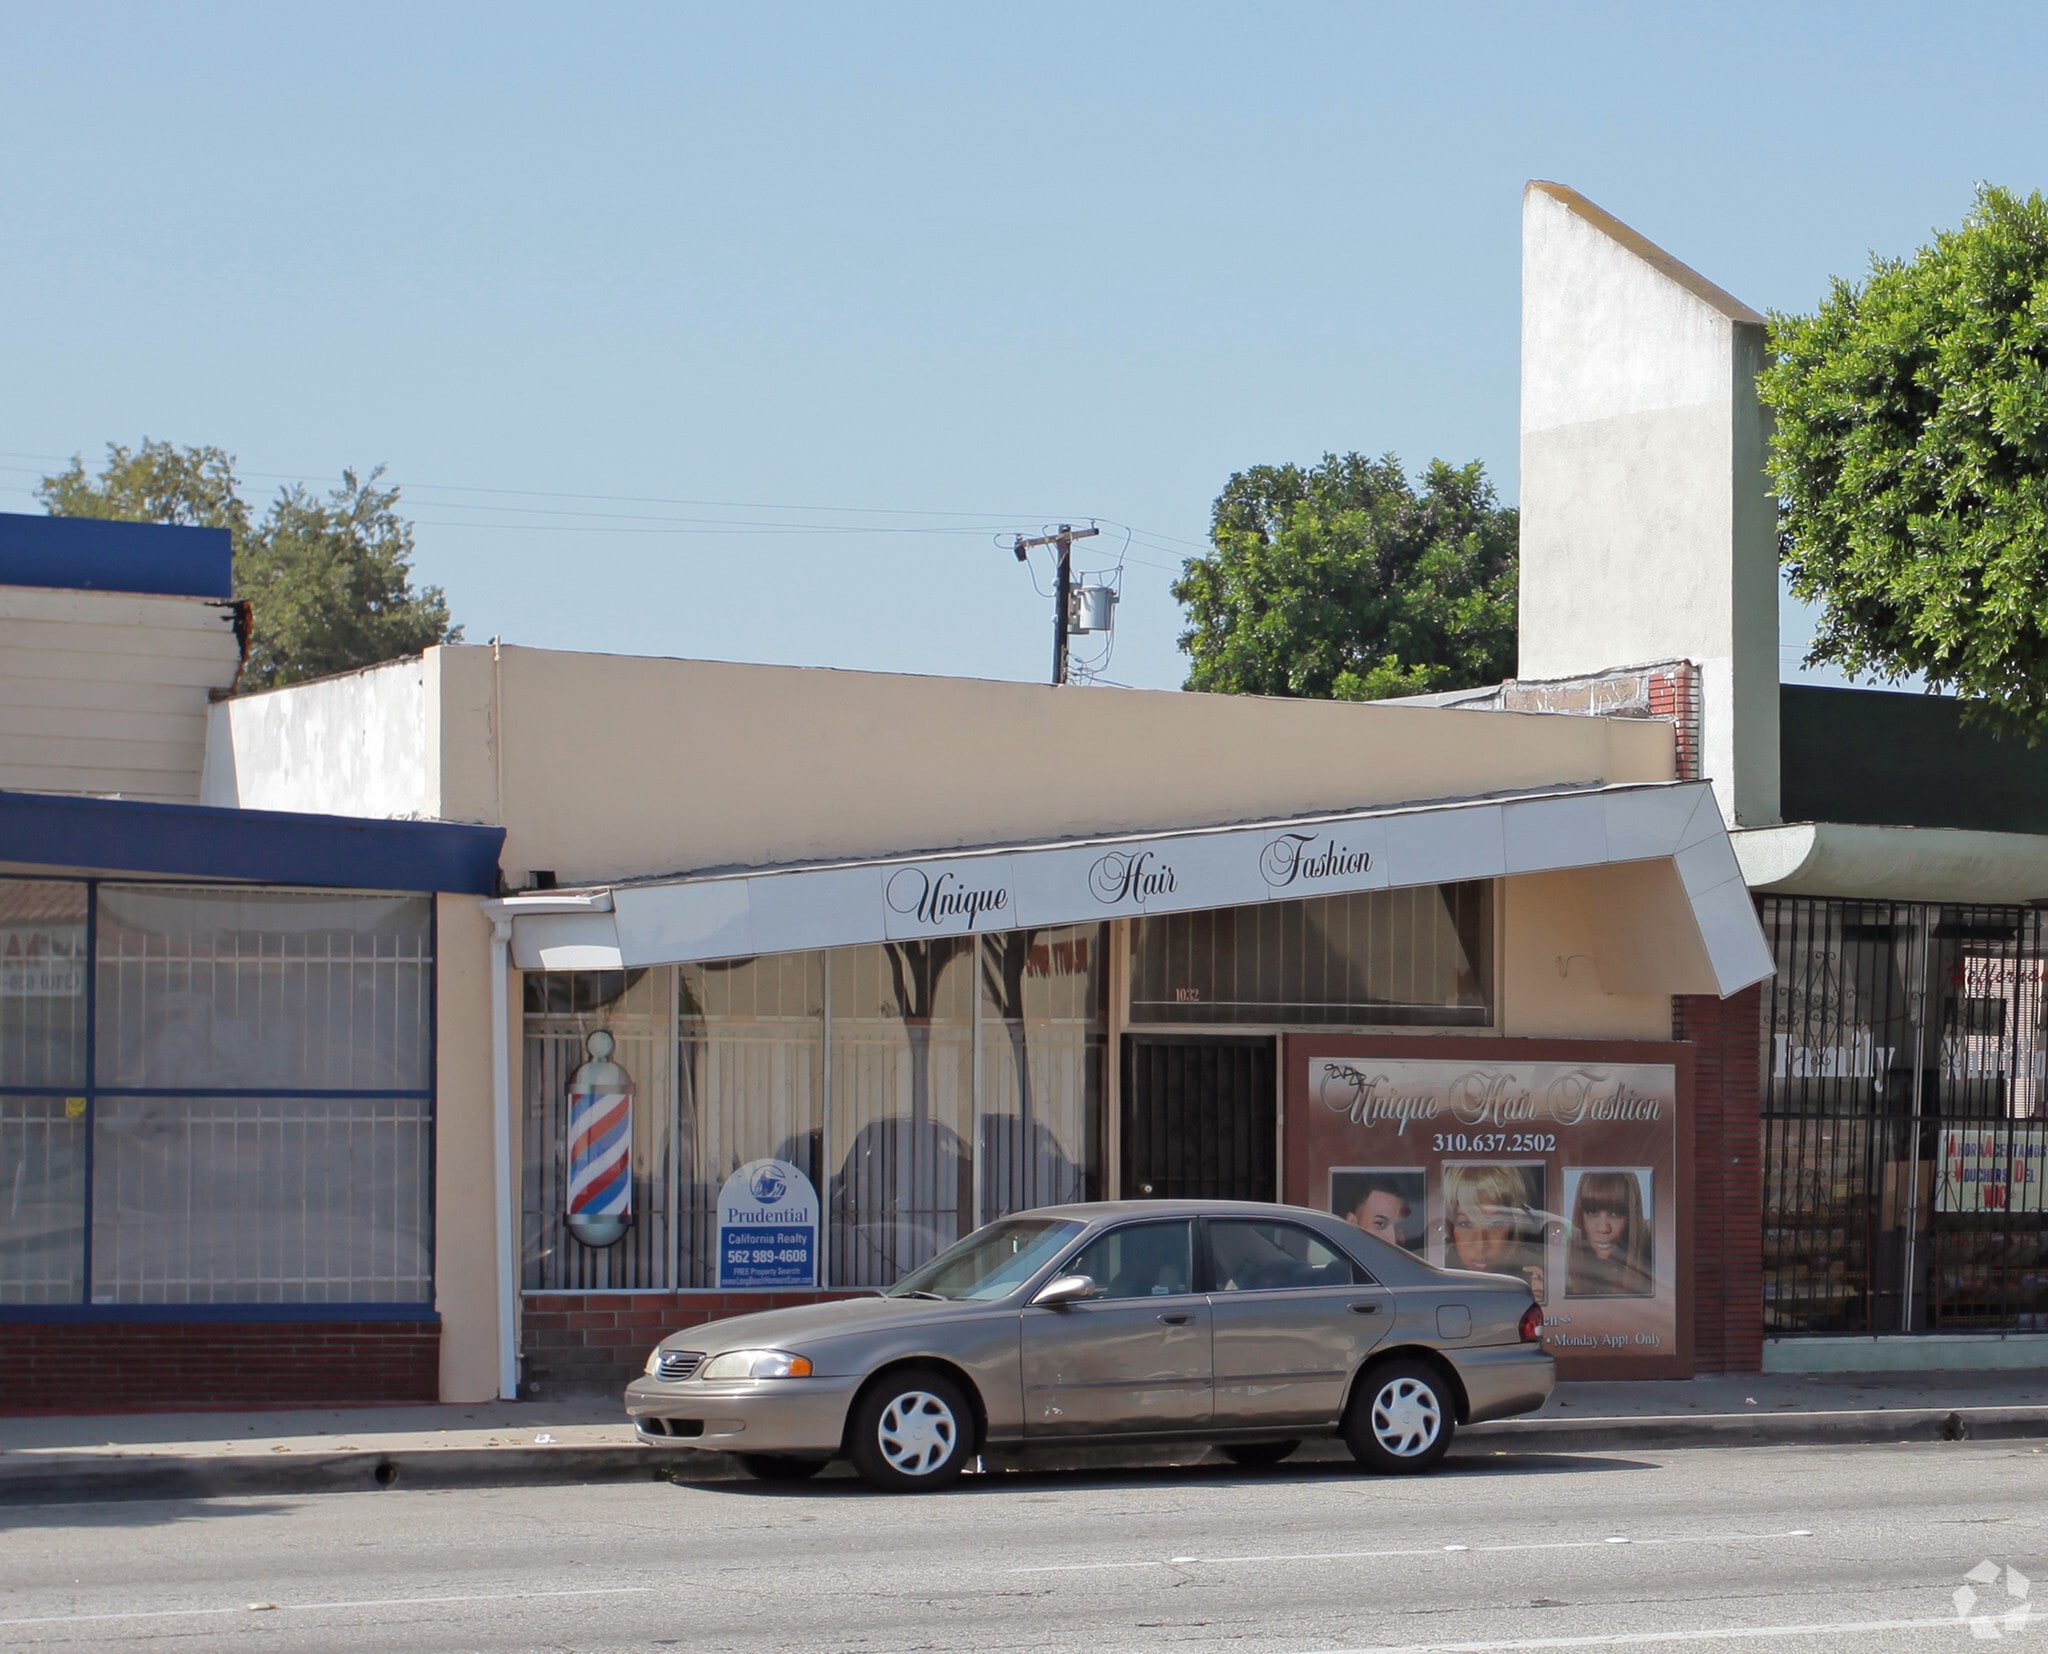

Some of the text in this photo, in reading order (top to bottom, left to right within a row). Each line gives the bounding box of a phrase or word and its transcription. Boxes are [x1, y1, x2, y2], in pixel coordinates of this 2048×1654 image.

[887, 833, 1374, 930] Unique Hair Fashion
[1175, 988, 1200, 1002] 1032
[1774, 1030, 1895, 1093] Family
[1320, 1073, 1439, 1136] Unique
[1449, 1070, 1538, 1128] Hair
[1549, 1070, 1663, 1126] Fashion
[1432, 1134, 1557, 1152] 310.637.2502
[728, 1208, 808, 1223] Prudential
[728, 1233, 807, 1245] California Realty
[728, 1249, 807, 1264] 562 989-4608
[1554, 1332, 1662, 1349] Monday Appt. Only
